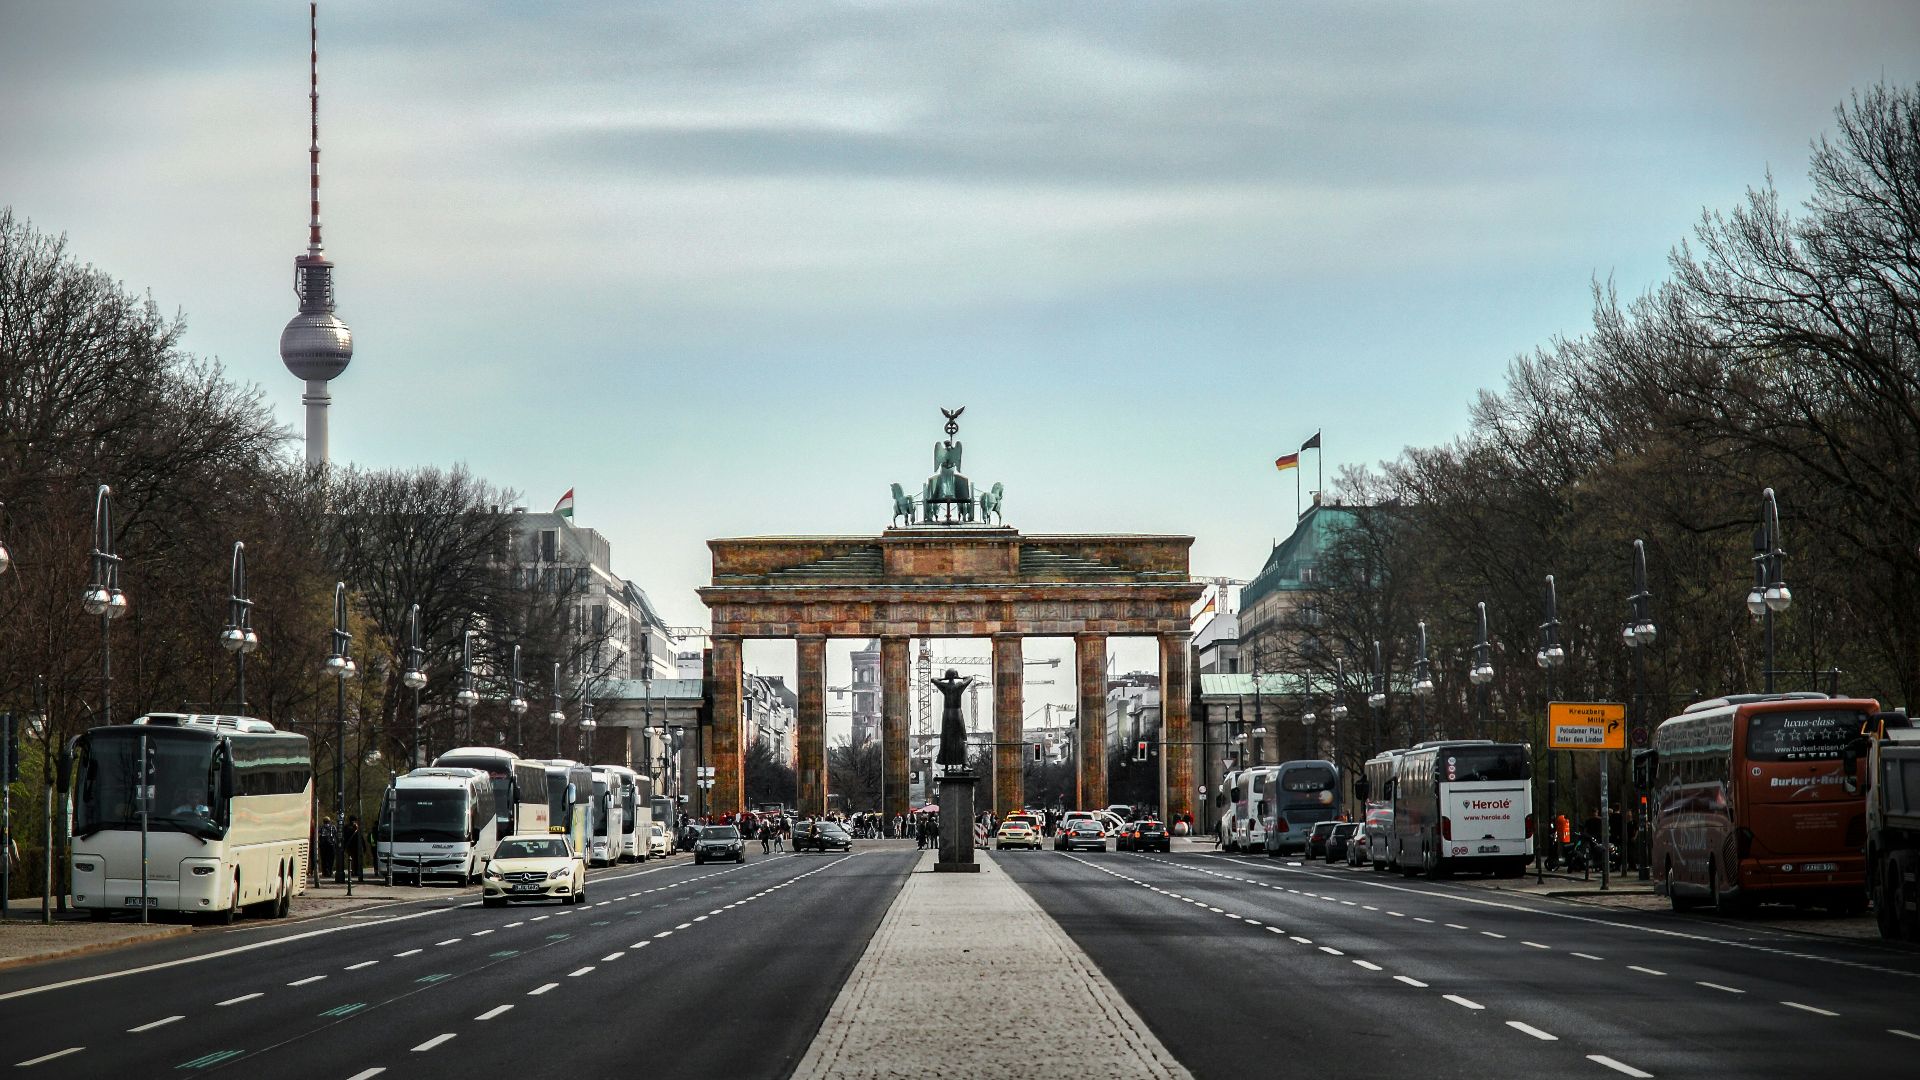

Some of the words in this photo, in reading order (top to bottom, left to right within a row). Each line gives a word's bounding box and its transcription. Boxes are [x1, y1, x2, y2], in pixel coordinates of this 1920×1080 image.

[1569, 708, 1605, 717] Kreuzberg
[1783, 717, 1835, 728] luxus-class
[1472, 798, 1511, 809] Herolé
